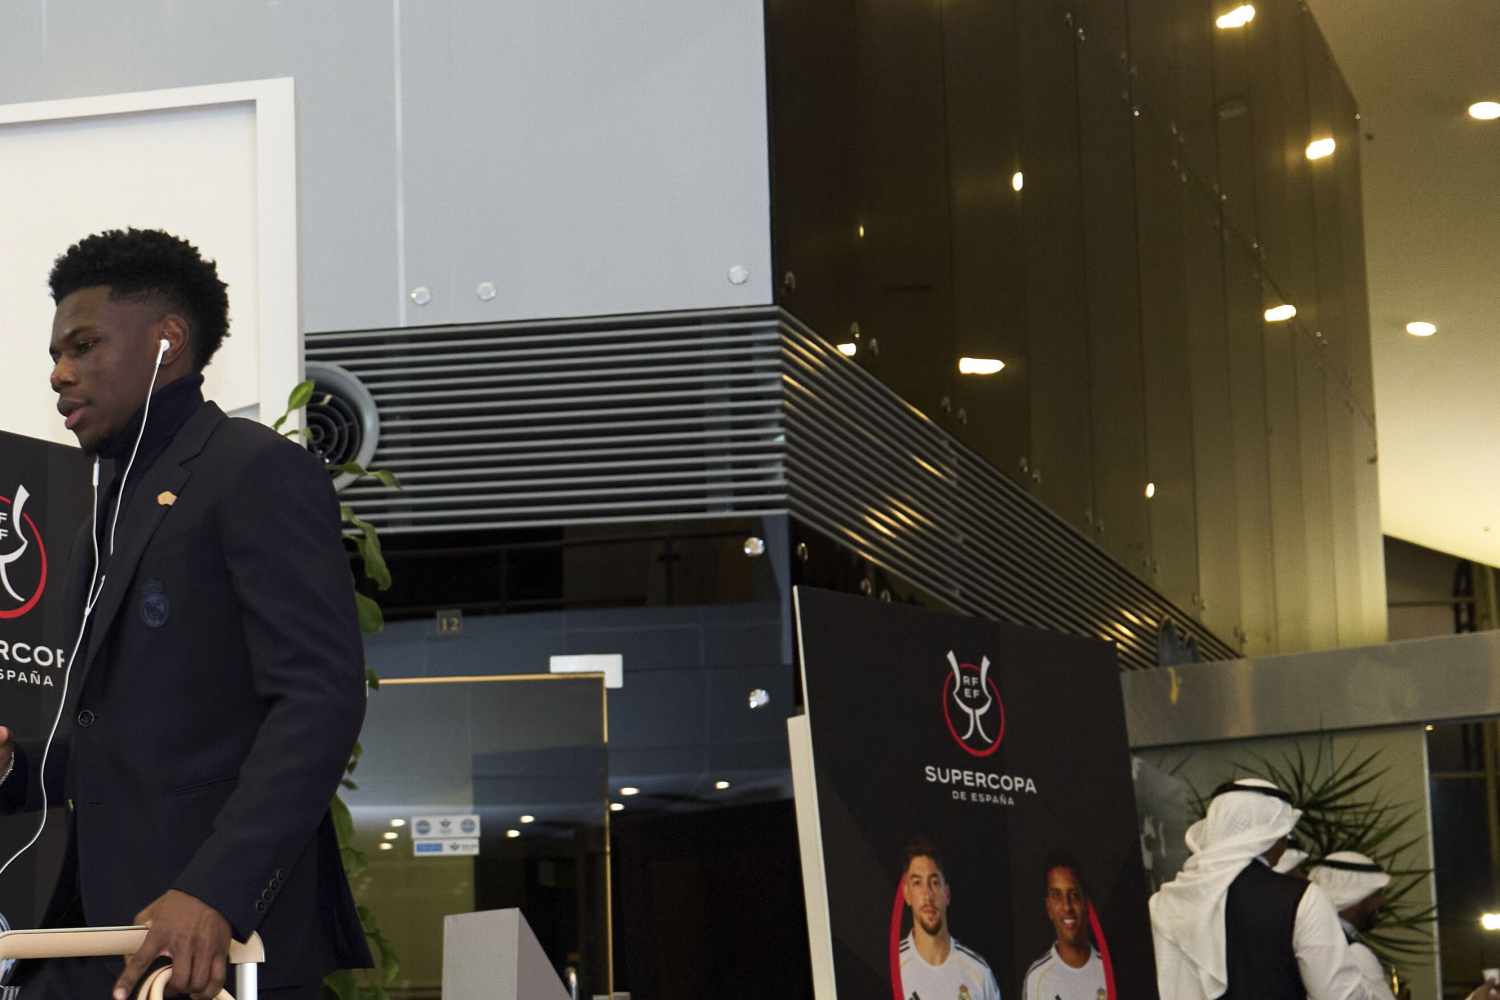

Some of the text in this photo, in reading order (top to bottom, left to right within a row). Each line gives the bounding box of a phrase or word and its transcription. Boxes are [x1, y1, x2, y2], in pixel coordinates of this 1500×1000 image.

[441, 617, 459, 632] 12
[962, 675, 979, 687] RF
[964, 688, 980, 699] EF
[924, 765, 1037, 794] SUPERCOPA
[952, 790, 1015, 806] DE ESPAÑA
